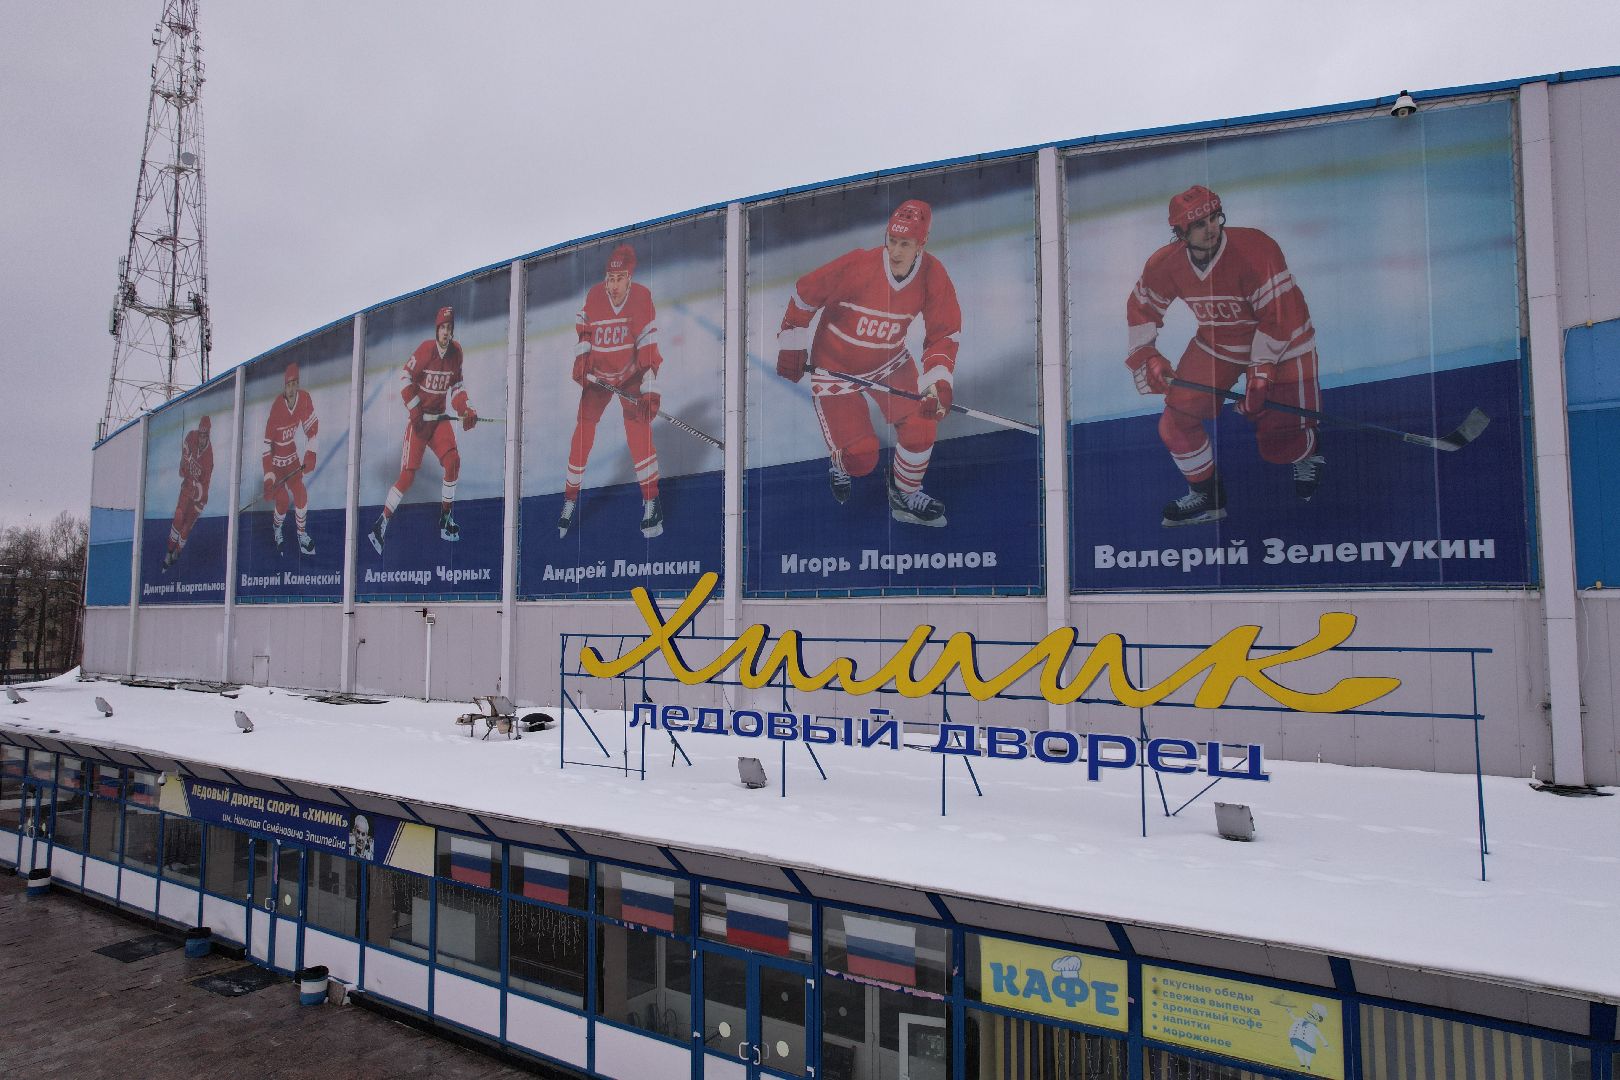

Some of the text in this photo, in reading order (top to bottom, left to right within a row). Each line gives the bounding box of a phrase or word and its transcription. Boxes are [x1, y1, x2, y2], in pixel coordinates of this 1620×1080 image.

[1187, 199, 1219, 220] СССР
[1193, 302, 1242, 319] СССР
[595, 325, 628, 345] СССР
[856, 316, 901, 342] СССР
[425, 373, 451, 390] СССР
[781, 549, 998, 577] Игорь Ларионов
[1094, 537, 1496, 572] Валерий Зелепукин
[241, 571, 341, 588] Валерий Каменский
[364, 566, 491, 585] Александр Черных
[542, 559, 701, 584] Андрей Ломакин
[143, 582, 225, 596] Дмитрий Квартальнов
[629, 700, 1271, 783] ледовый дворец
[192, 784, 229, 803] ЛЕДОВЫЙ
[231, 792, 265, 812] ДВОРЕЦ
[267, 800, 300, 817] СПОРТА
[305, 830, 347, 850] Эпштейна
[989, 962, 1120, 1017] КАФЕ
[1163, 978, 1254, 1002] вкусные обеды
[1163, 990, 1261, 1016] свежая выпечка
[1163, 1003, 1263, 1029] ароматный кофе
[1163, 1015, 1210, 1030] напитки
[1163, 1027, 1232, 1048] мороженое
